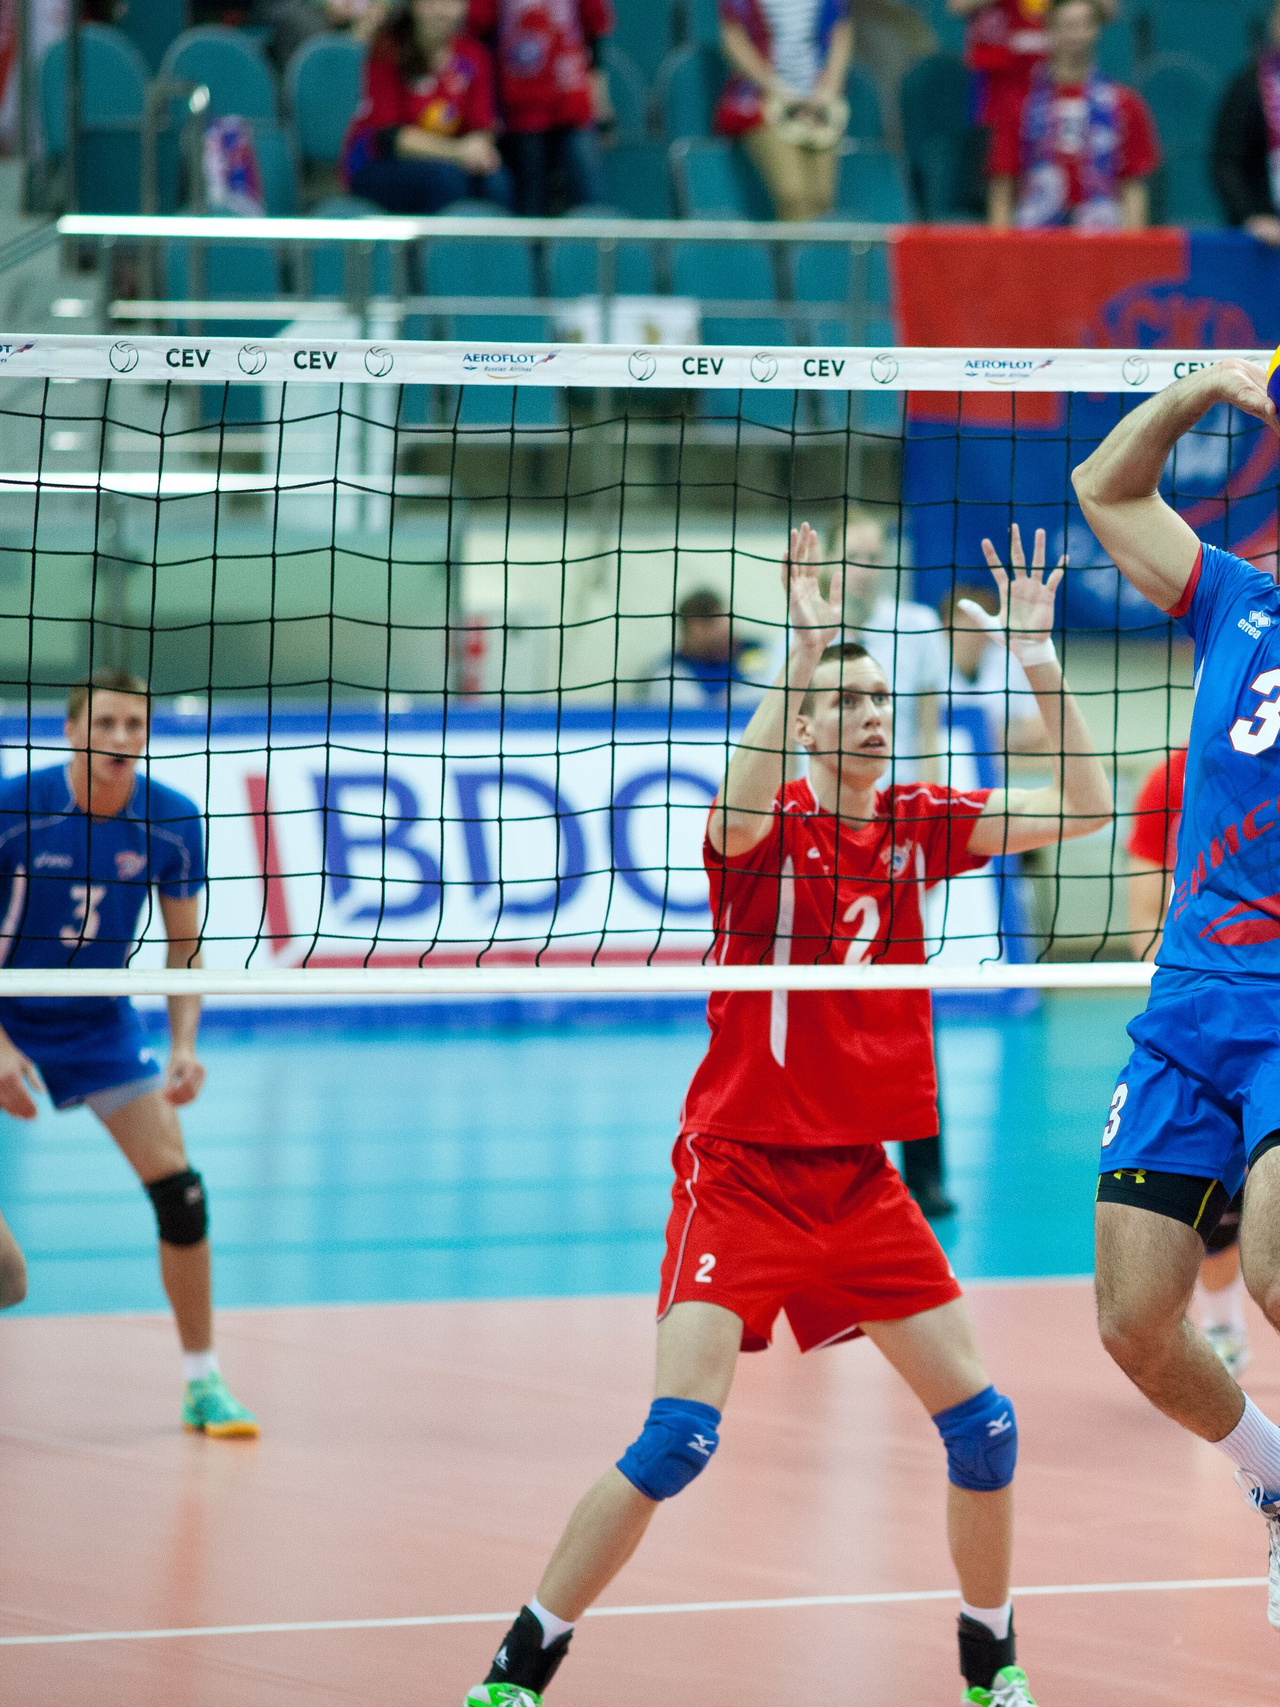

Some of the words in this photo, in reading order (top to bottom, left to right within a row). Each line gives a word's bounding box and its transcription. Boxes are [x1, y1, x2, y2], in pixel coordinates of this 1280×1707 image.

[166, 348, 211, 368] CEV
[293, 350, 338, 370] CEV
[463, 353, 535, 363] AEROFLOT
[682, 357, 724, 375] CEV
[803, 358, 845, 377] CEV
[964, 360, 1034, 369] AEROFLOT
[1237, 618, 1262, 640] errea
[60, 885, 107, 948] 3
[842, 895, 880, 965] 2
[1101, 1081, 1129, 1149] 3
[695, 1253, 716, 1283] 2
